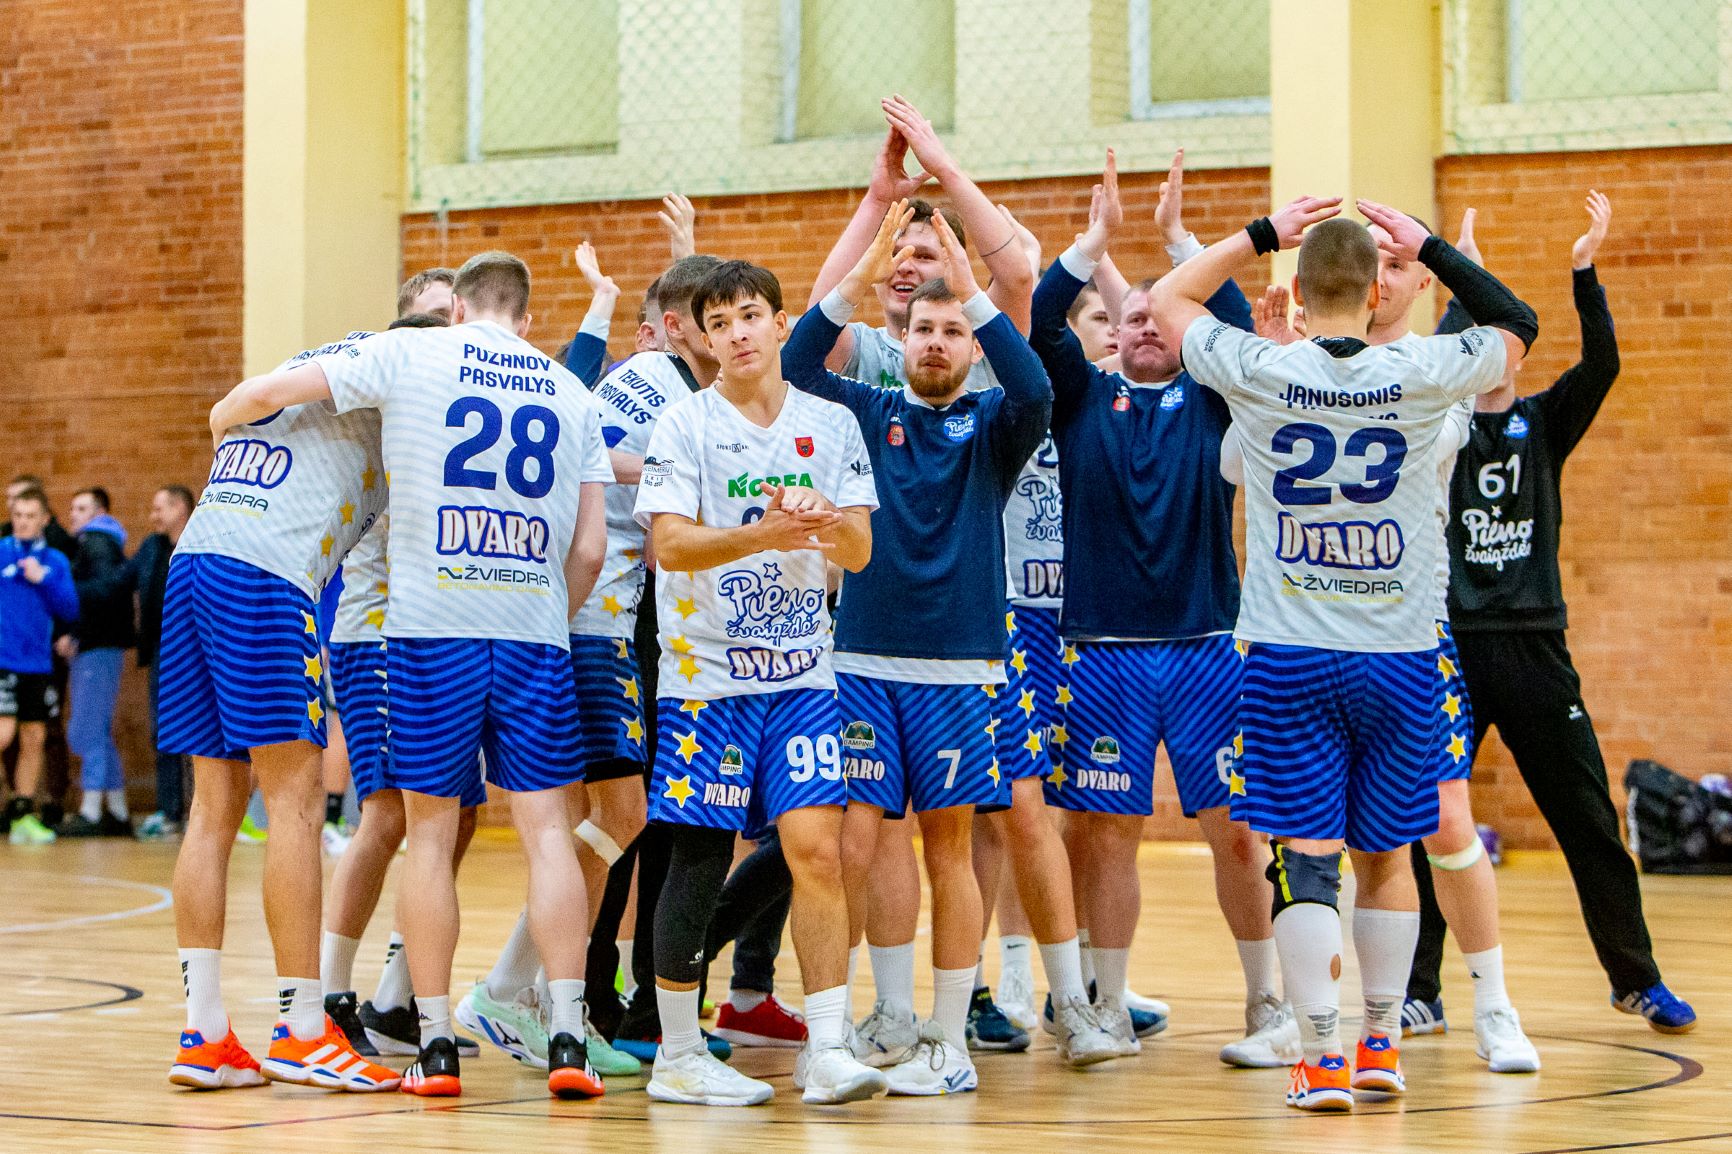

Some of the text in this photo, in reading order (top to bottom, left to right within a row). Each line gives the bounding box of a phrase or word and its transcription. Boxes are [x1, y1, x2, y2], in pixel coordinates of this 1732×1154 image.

[459, 366, 556, 396] PASVALYS
[618, 369, 666, 408] TEKUTIS
[597, 383, 652, 424] PASVALYS
[443, 396, 560, 499] 28
[1271, 422, 1408, 506] 23
[1478, 454, 1520, 499] 61
[436, 505, 550, 564] DVARO
[1275, 511, 1405, 570] DVARO
[1461, 508, 1535, 547] Pieno
[464, 565, 550, 587] ŽVIEDRA
[718, 570, 825, 619] Pieno
[1303, 574, 1404, 595] ŽVIEDRA
[726, 612, 821, 648] žvaigždės
[787, 734, 841, 783] 99
[937, 748, 961, 789] 7
[1077, 768, 1131, 792] DVARO
